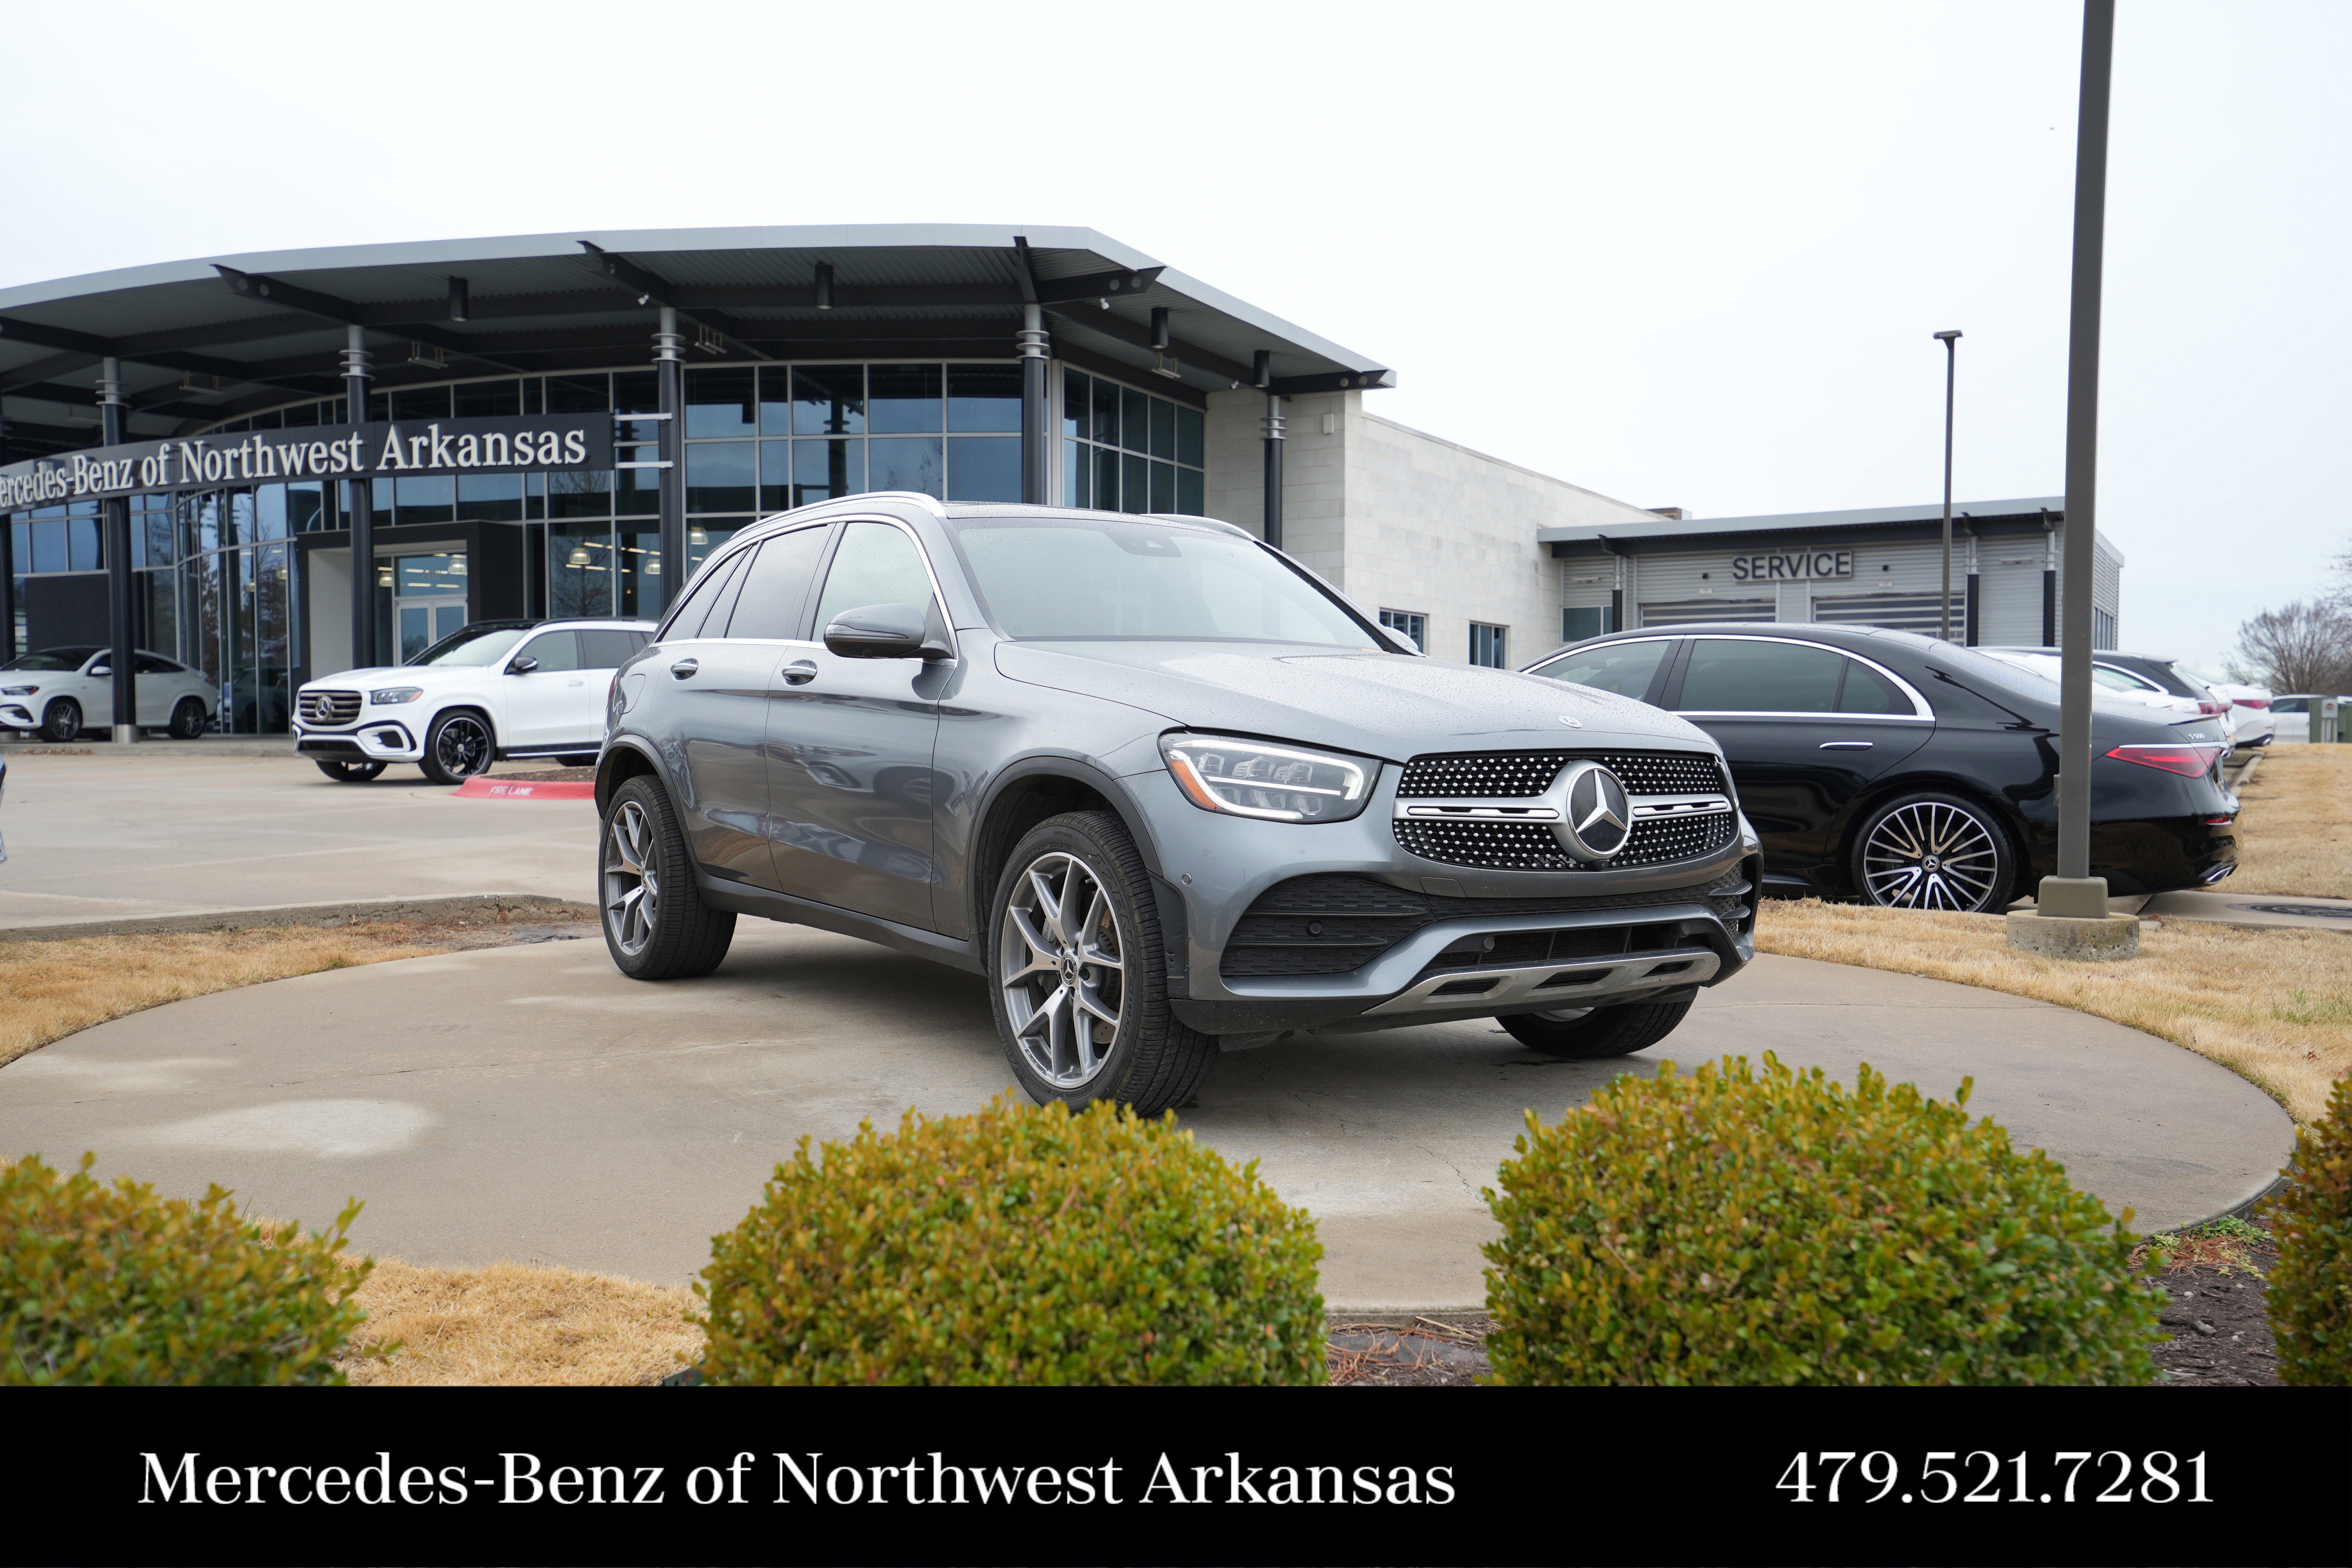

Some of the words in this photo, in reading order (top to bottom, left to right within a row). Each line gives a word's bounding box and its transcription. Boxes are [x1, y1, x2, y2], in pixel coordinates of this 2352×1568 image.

[0, 455, 134, 508] ercedes-Benz
[142, 443, 170, 486] of
[179, 431, 364, 483] Northwest
[376, 423, 586, 471] Arkansas
[1733, 552, 1850, 579] SERVICE
[490, 786, 509, 795] FIRE
[508, 786, 534, 796] LANE
